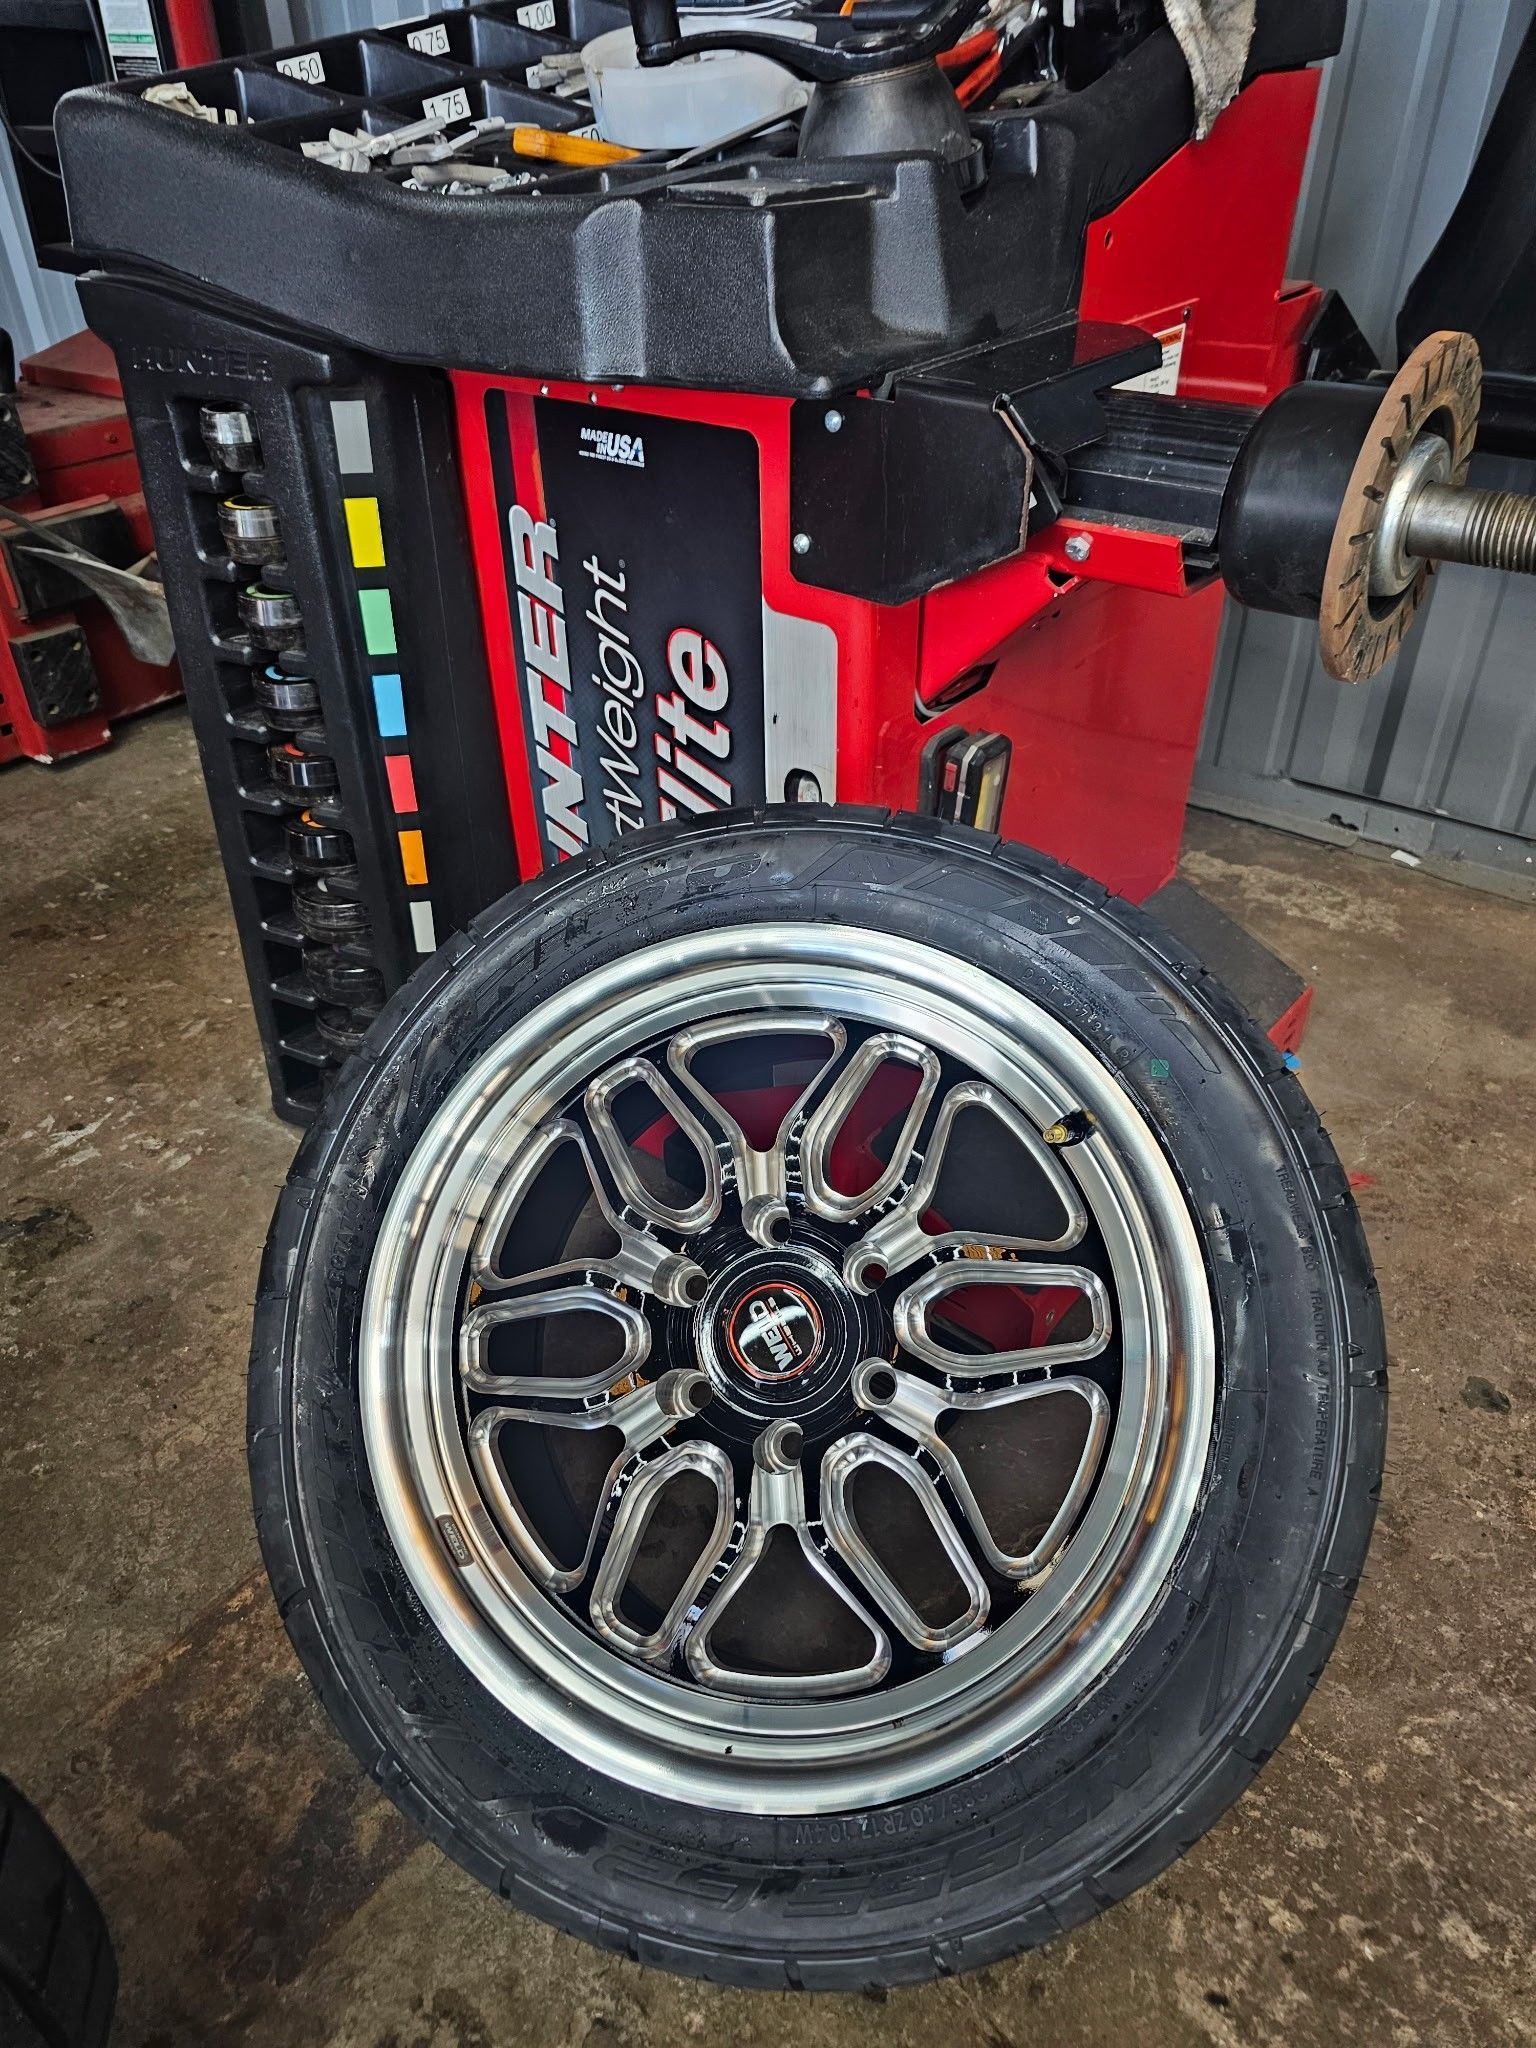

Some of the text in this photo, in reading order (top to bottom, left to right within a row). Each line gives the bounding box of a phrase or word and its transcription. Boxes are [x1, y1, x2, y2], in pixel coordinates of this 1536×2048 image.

[412, 28, 445, 53] 075
[282, 57, 319, 81] 050
[429, 93, 463, 119] 175
[580, 427, 609, 443] MADE
[596, 442, 608, 455] IN
[607, 432, 645, 463] USA
[508, 504, 590, 857] NTER
[653, 627, 733, 824] lite
[1272, 1164, 1311, 1239] TREADWEAR
[1308, 1288, 1328, 1351] TRACTION
[1308, 1383, 1329, 1481] TEMPERATURE
[444, 1521, 465, 1560] WELD
